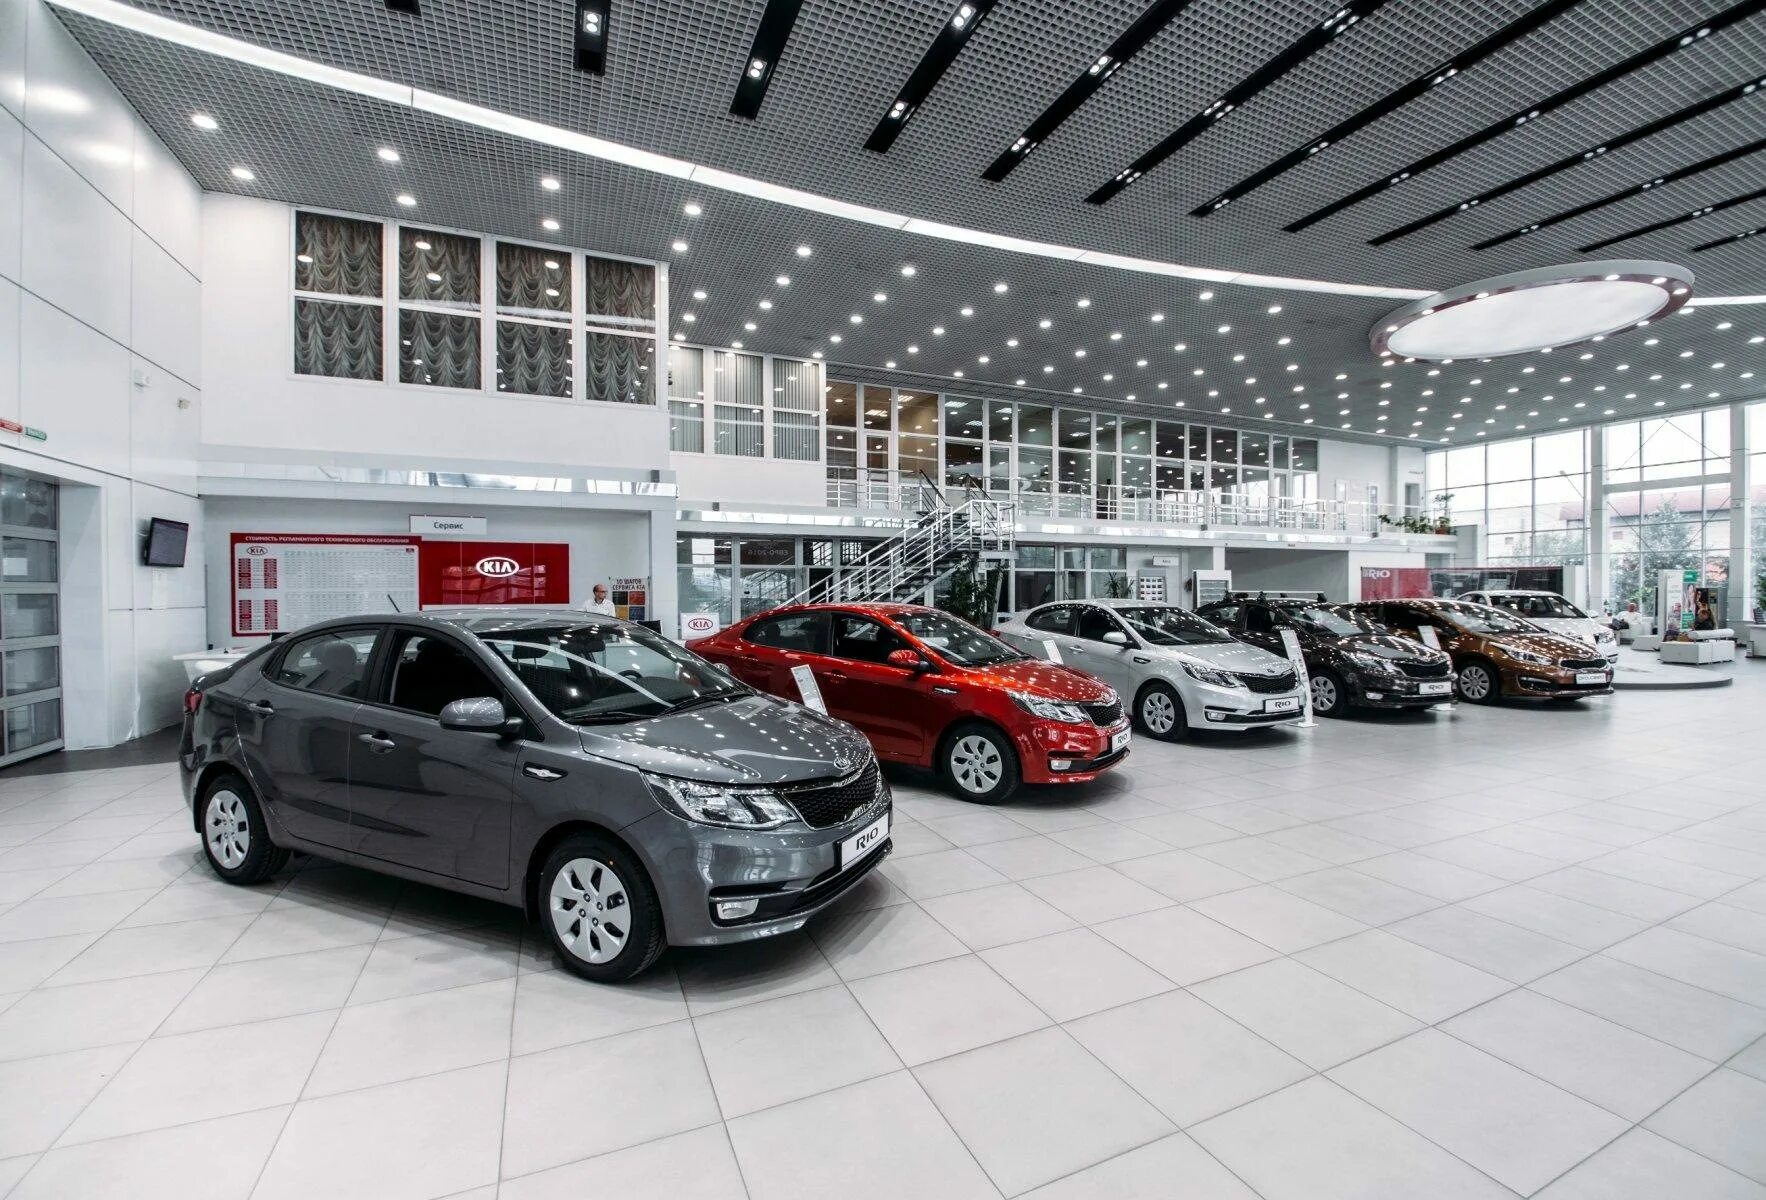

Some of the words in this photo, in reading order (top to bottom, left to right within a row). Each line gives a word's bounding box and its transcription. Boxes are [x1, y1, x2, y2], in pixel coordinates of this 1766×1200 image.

[433, 521, 464, 530] Сервис
[483, 561, 512, 573] KIA
[1368, 569, 1391, 579] RIO
[1275, 700, 1291, 708] RIO
[855, 827, 879, 850] RIO
